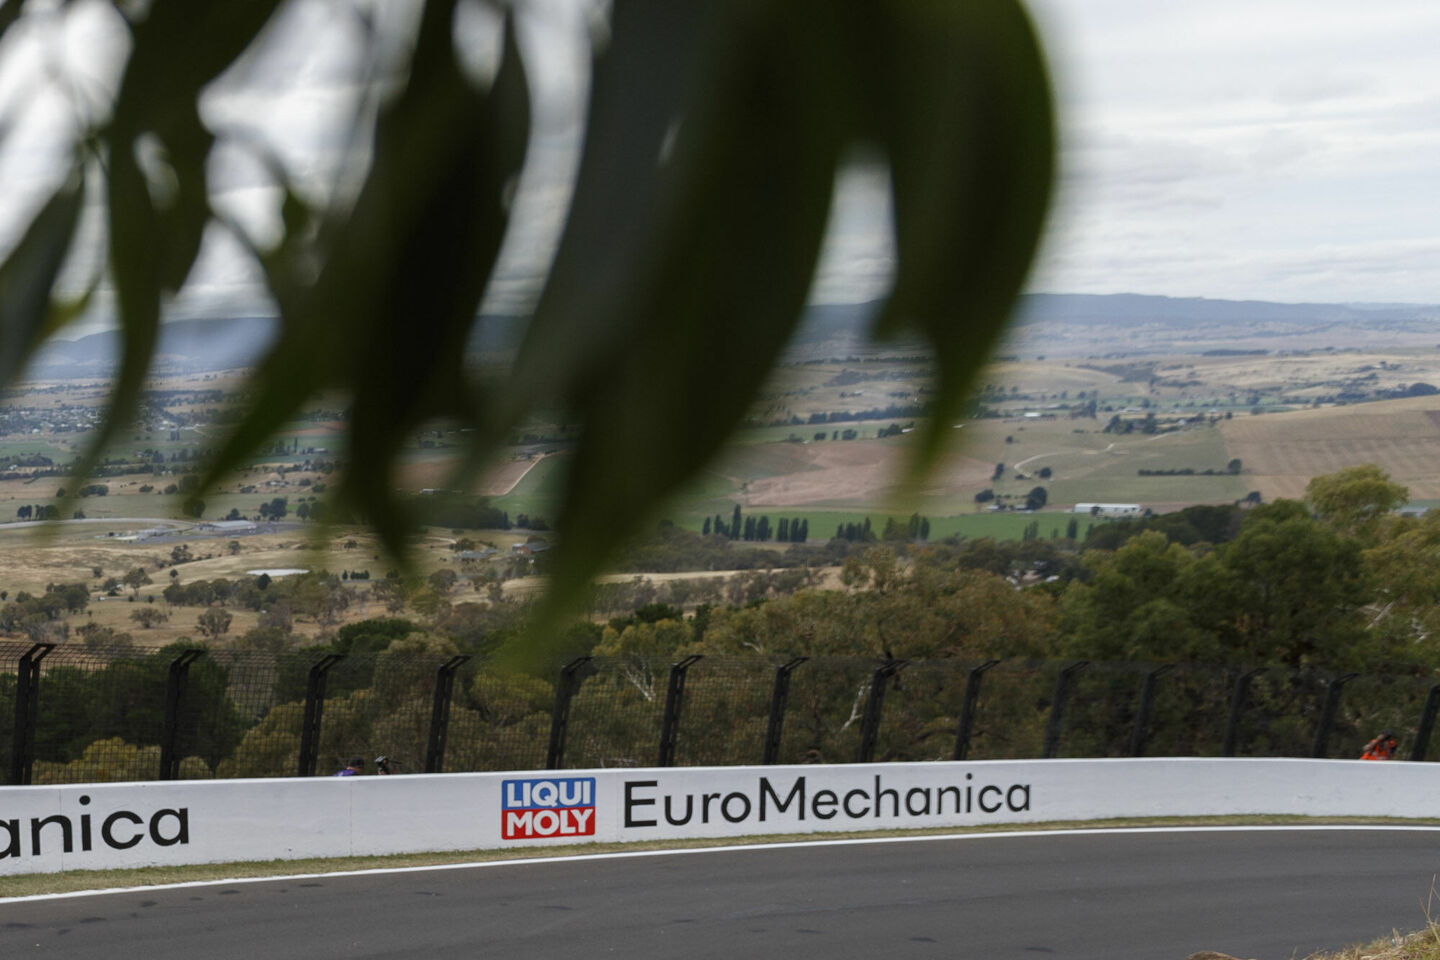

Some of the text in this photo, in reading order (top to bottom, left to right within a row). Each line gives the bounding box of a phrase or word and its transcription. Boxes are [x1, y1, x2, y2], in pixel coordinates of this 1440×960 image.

[507, 781, 591, 808] LIQUI
[624, 773, 1031, 828] EuroMechanica
[506, 808, 594, 837] MOLY
